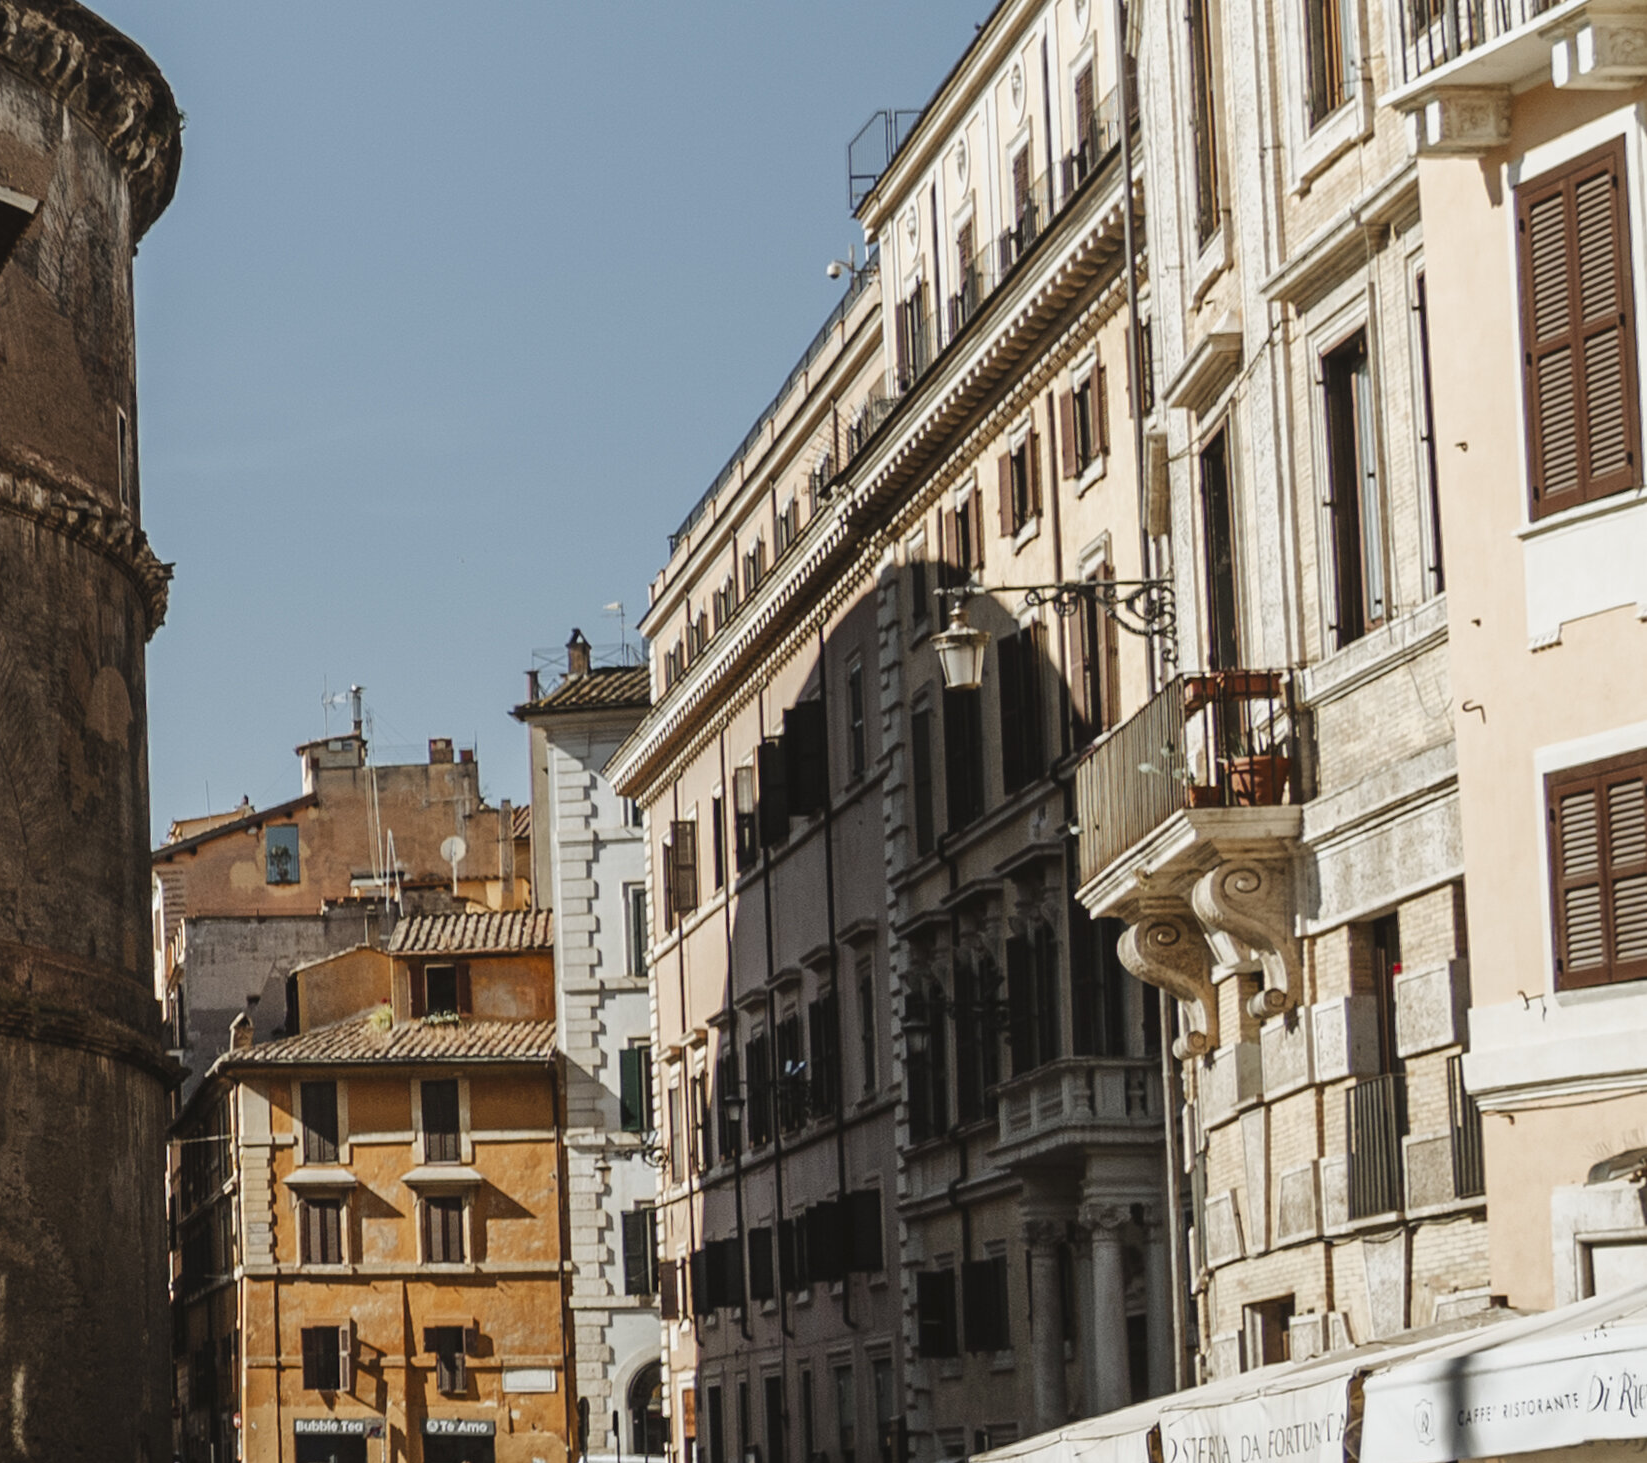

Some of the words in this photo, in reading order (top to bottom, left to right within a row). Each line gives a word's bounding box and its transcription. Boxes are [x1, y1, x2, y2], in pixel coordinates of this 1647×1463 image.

[1503, 1392, 1579, 1419] RISTORANTE
[1587, 1372, 1614, 1412] Di
[295, 1419, 338, 1433] Bubble
[341, 1420, 364, 1433] Tea
[457, 1420, 488, 1434] Amo
[1240, 1434, 1262, 1463] DA
[1268, 1412, 1346, 1459] FORTUNTA
